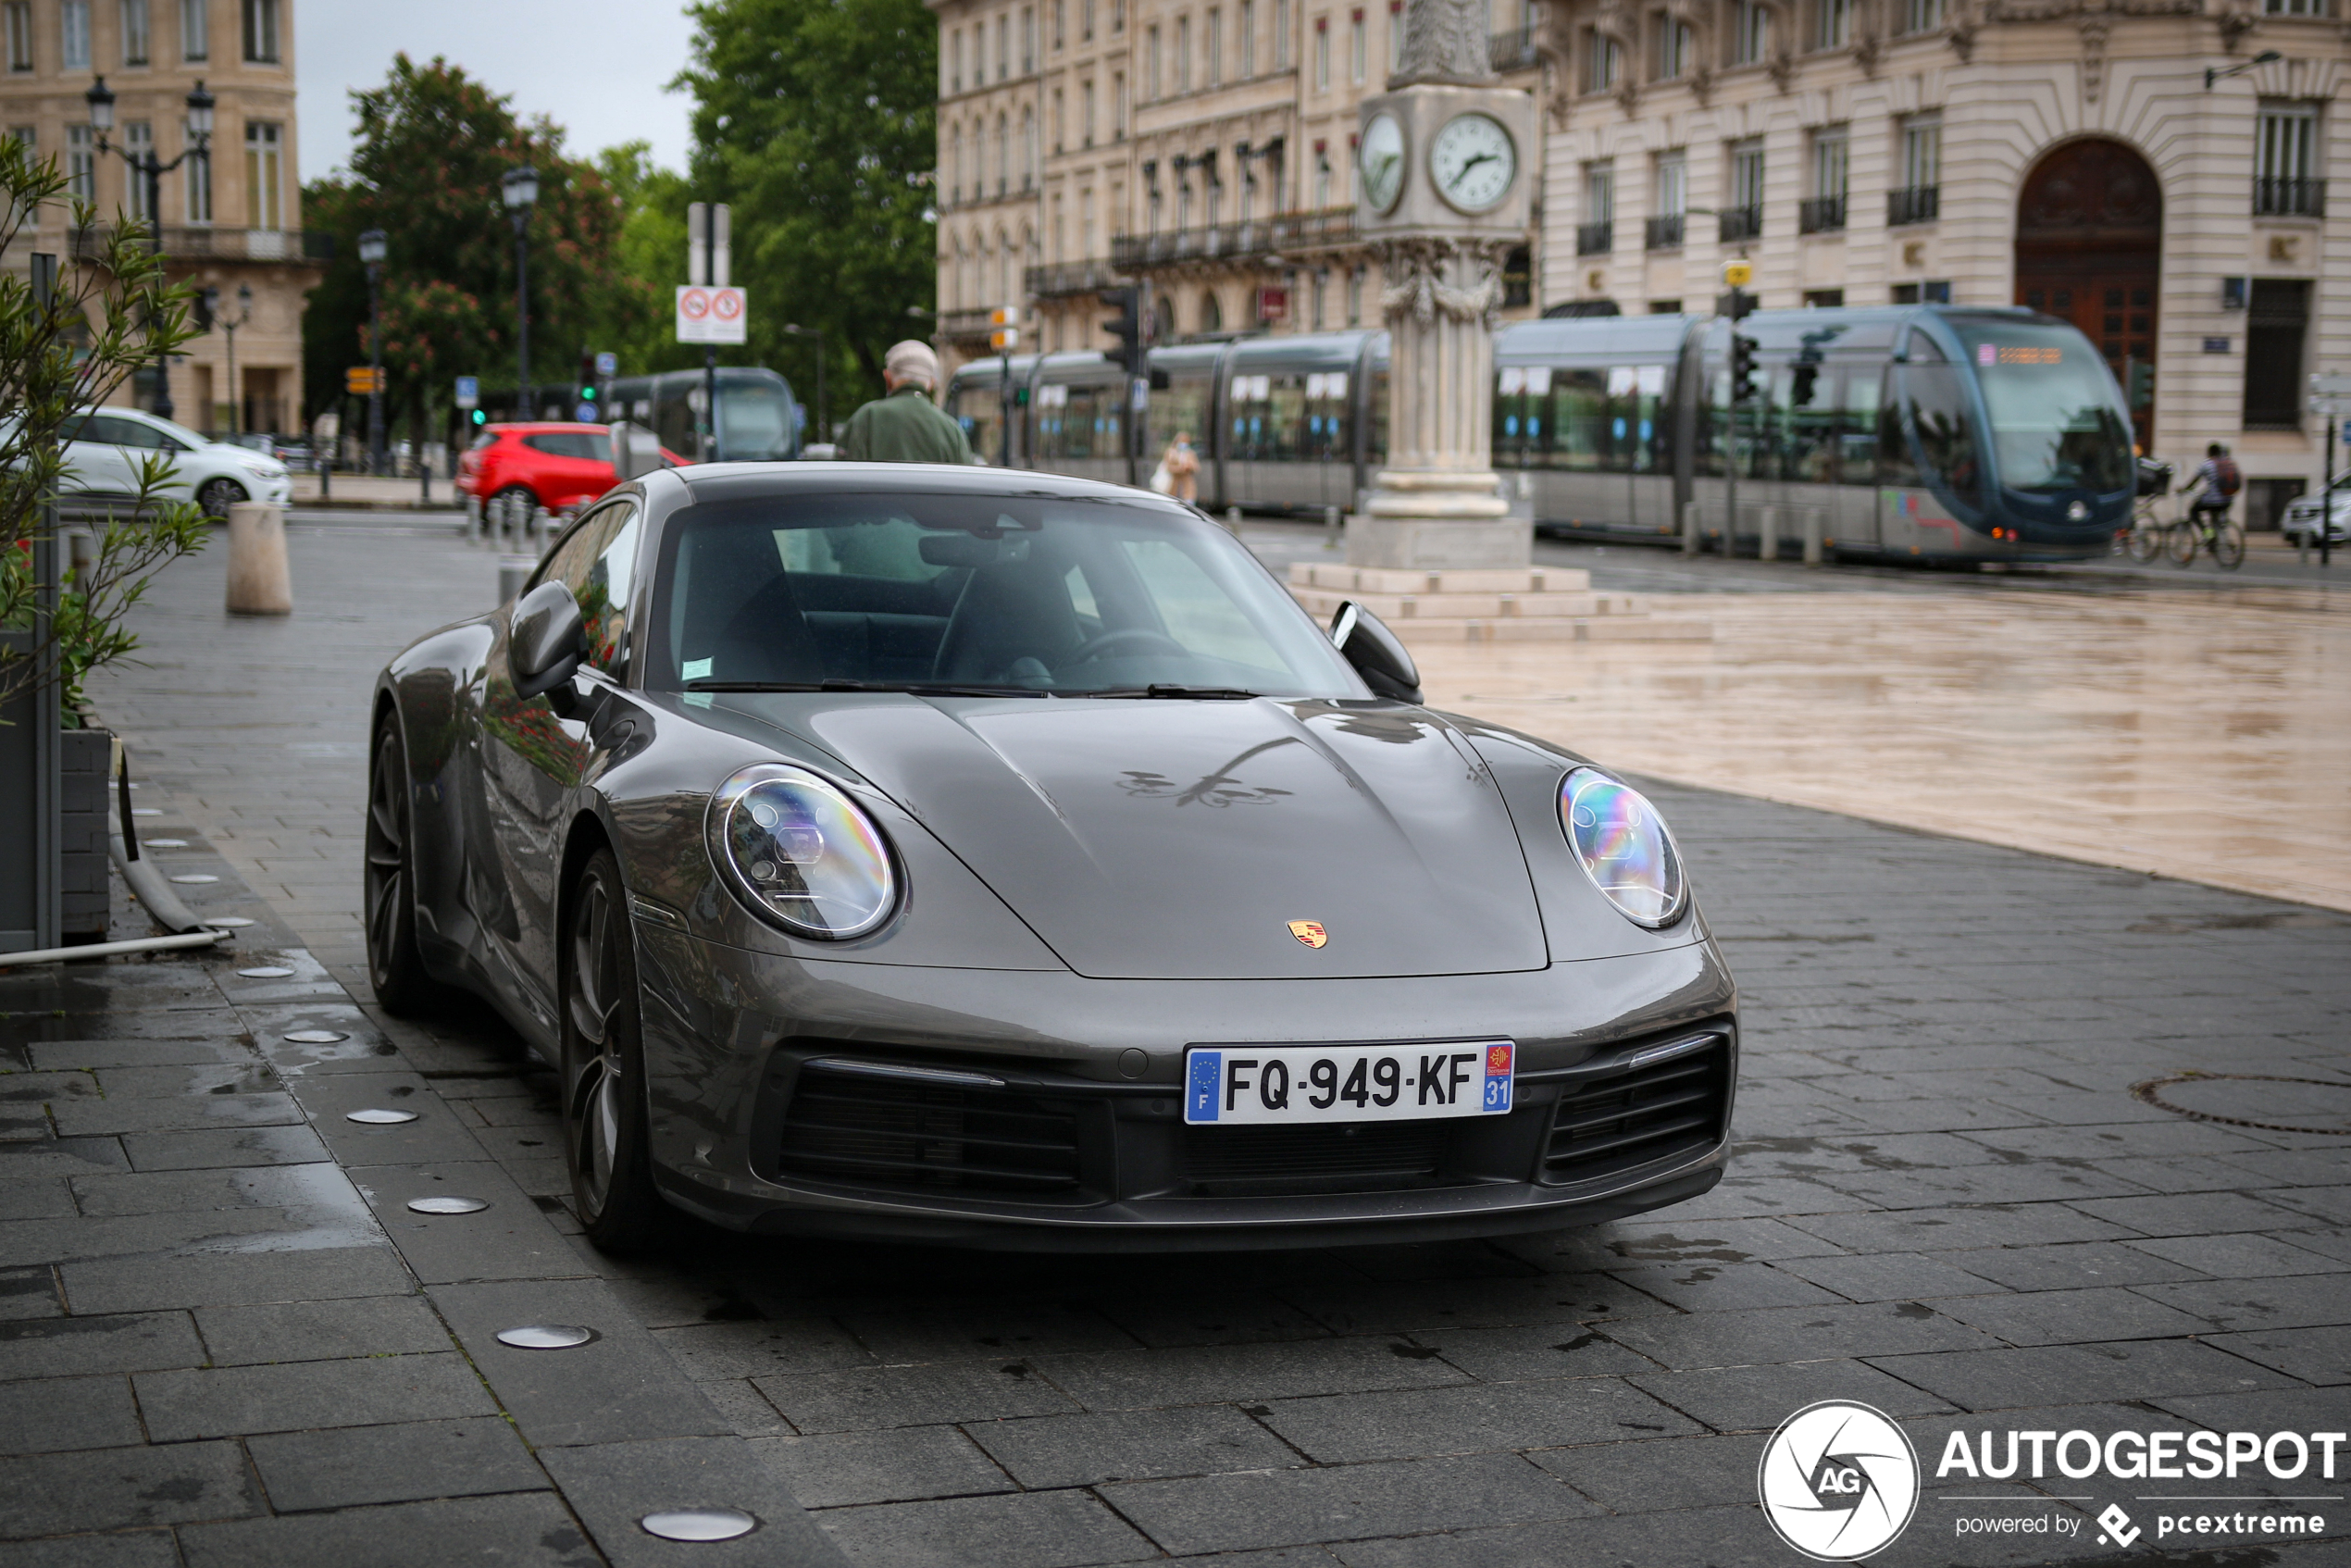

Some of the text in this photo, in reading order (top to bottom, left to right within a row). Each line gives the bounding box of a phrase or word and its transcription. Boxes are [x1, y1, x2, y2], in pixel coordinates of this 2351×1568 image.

[1226, 1053, 1477, 1111] FQ-949-KF
[1486, 1080, 1509, 1105] 31
[1199, 1094, 1209, 1109] F
